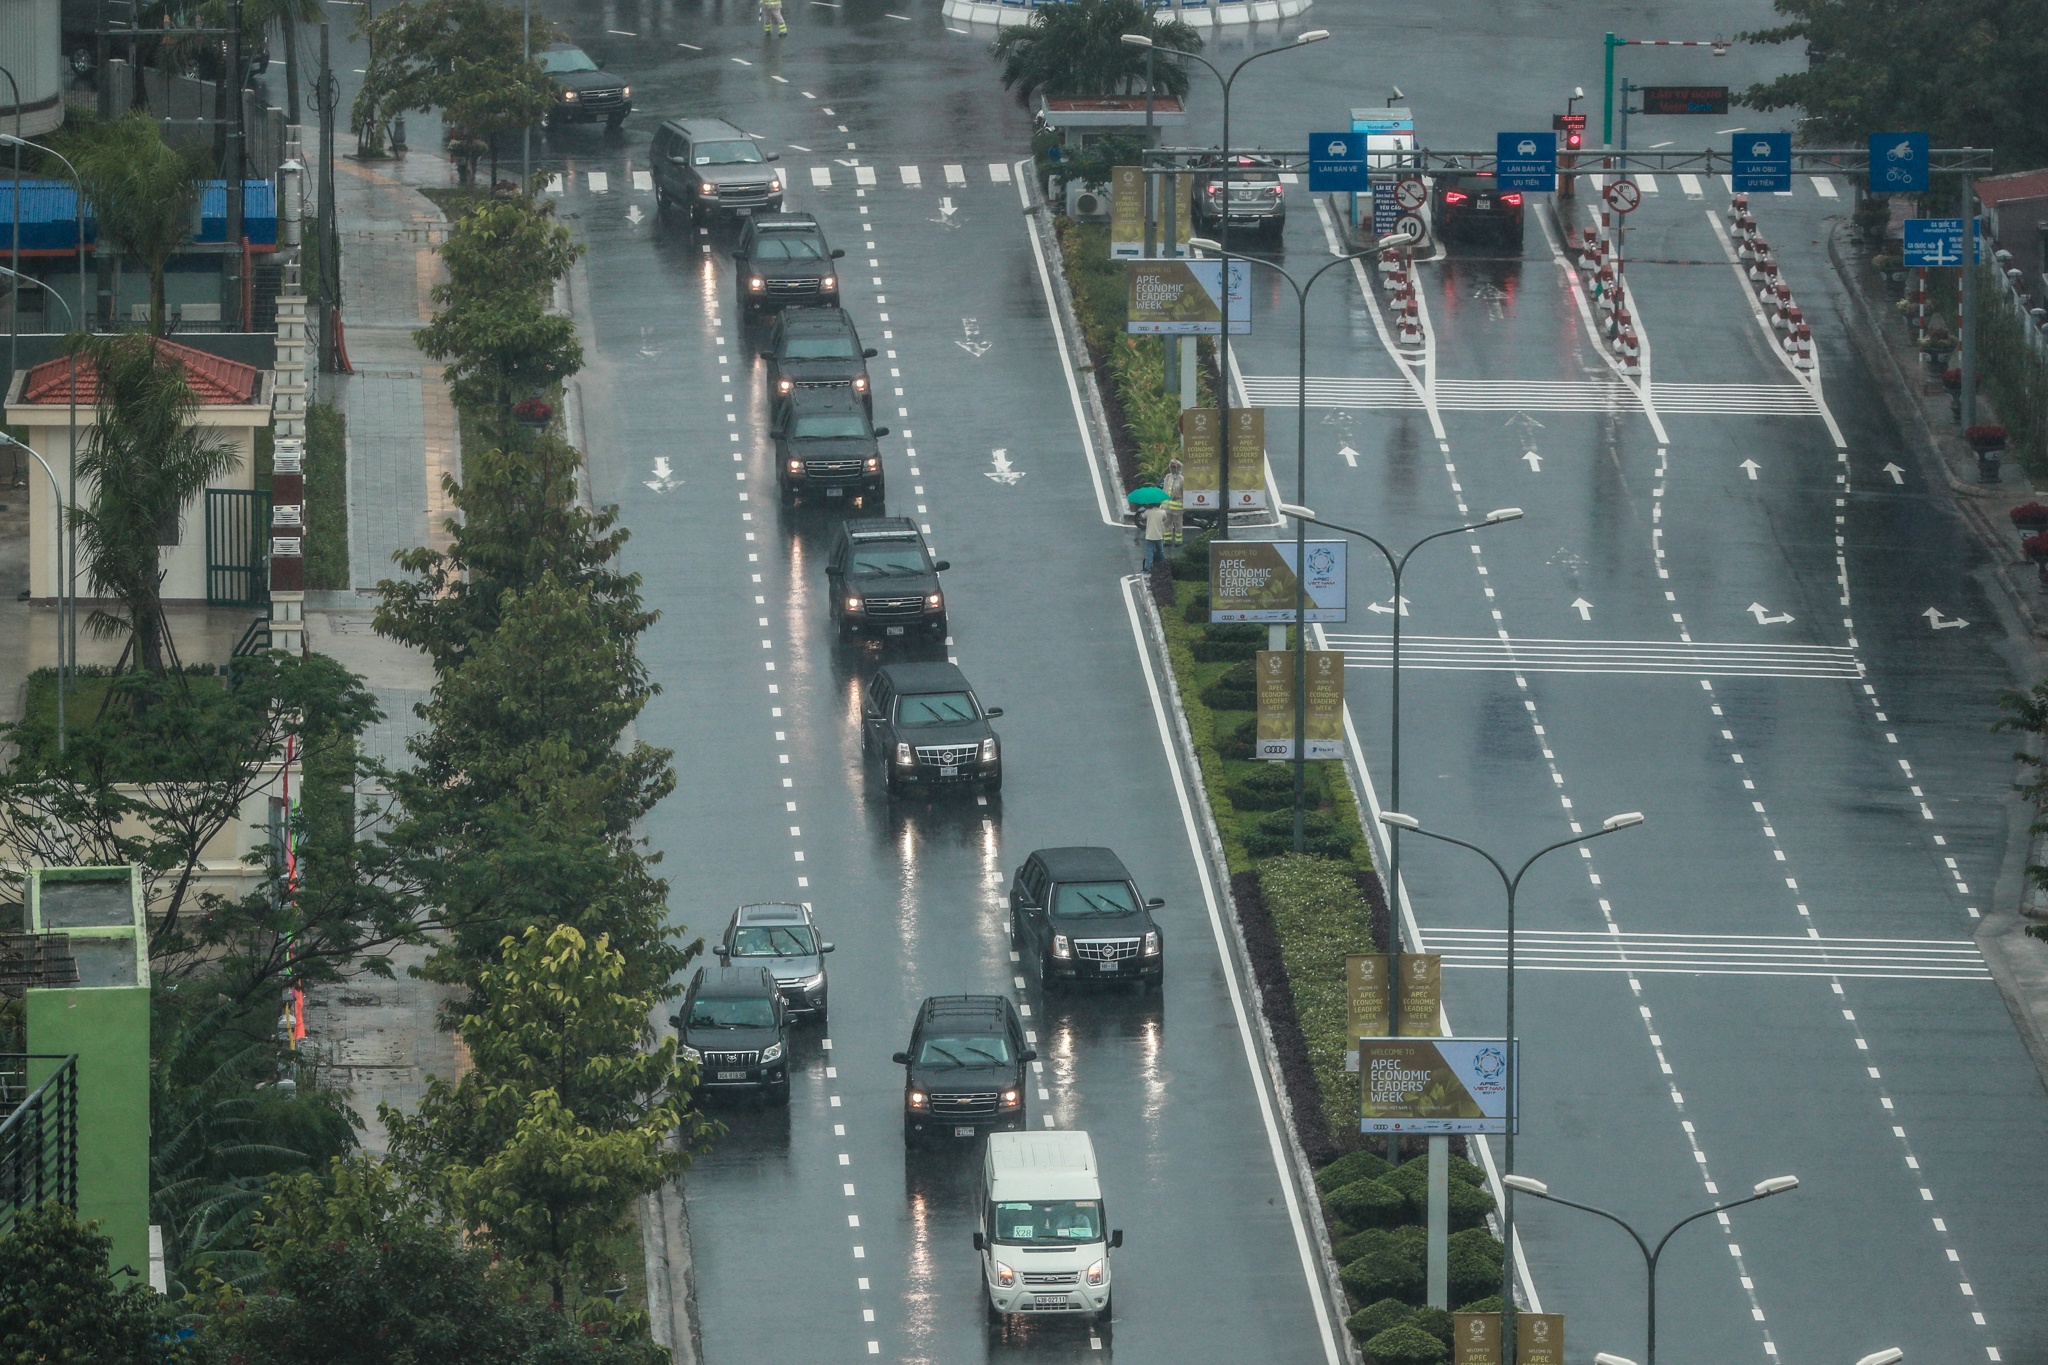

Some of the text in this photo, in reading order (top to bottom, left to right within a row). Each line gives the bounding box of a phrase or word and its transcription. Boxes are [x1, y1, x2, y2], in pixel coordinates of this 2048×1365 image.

[1402, 222, 1417, 237] 10
[1136, 276, 1160, 284] APEC
[1137, 284, 1184, 292] ECONOMIC
[1137, 292, 1180, 301] LEADERS'
[1136, 301, 1162, 310] WEEK
[1219, 560, 1245, 568] APEC
[1220, 568, 1271, 578] ECONOMIC
[1220, 578, 1267, 587] LEADERS'
[1220, 587, 1248, 596] WEEK
[1371, 1059, 1401, 1070] APEC
[1371, 1070, 1431, 1080] ECONOMIC
[1371, 1080, 1427, 1092] LEADERS'
[1371, 1092, 1404, 1102] WEEK
[1015, 1229, 1031, 1237] X28
